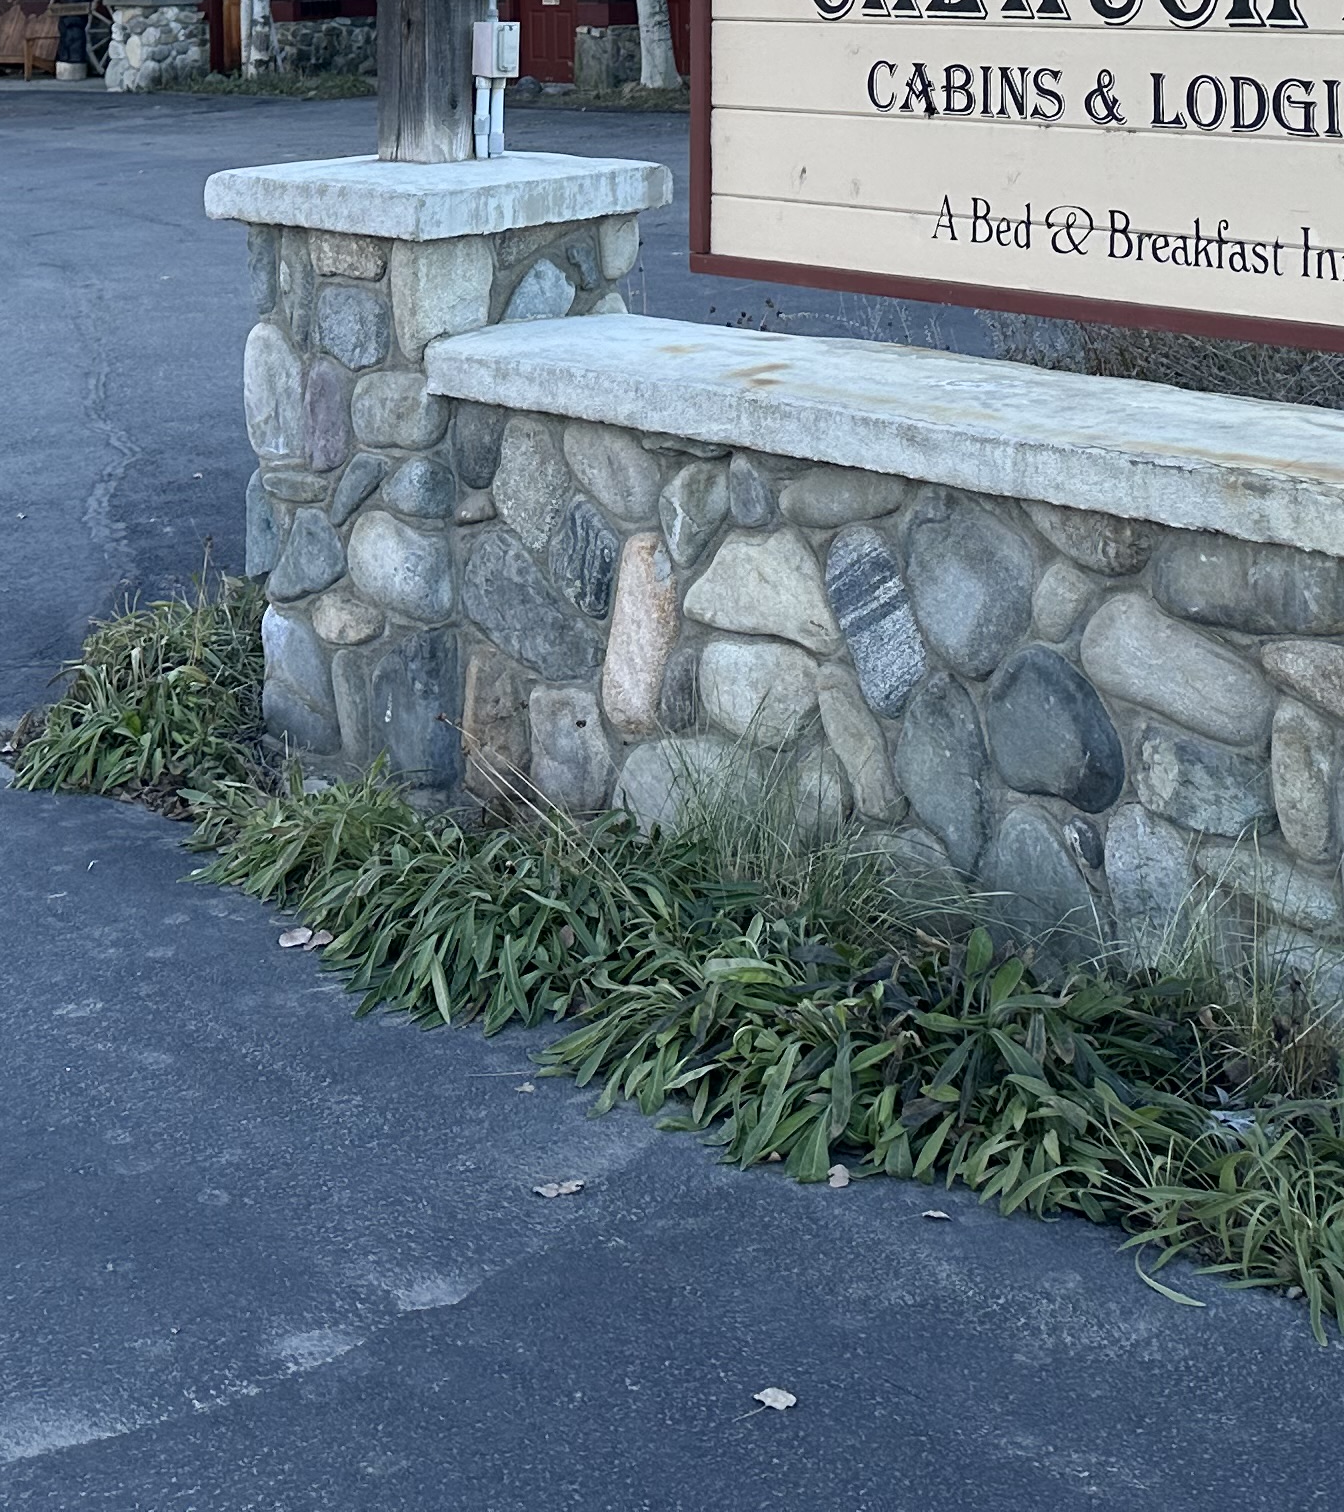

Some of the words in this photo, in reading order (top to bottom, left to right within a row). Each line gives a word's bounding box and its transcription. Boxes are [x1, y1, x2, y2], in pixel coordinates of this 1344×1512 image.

[867, 60, 1065, 125] CABINS
[1084, 68, 1128, 126] &
[931, 194, 958, 242] A
[970, 196, 1033, 252] Bed
[1044, 204, 1095, 256] &
[1107, 209, 1286, 278] Breakfast
